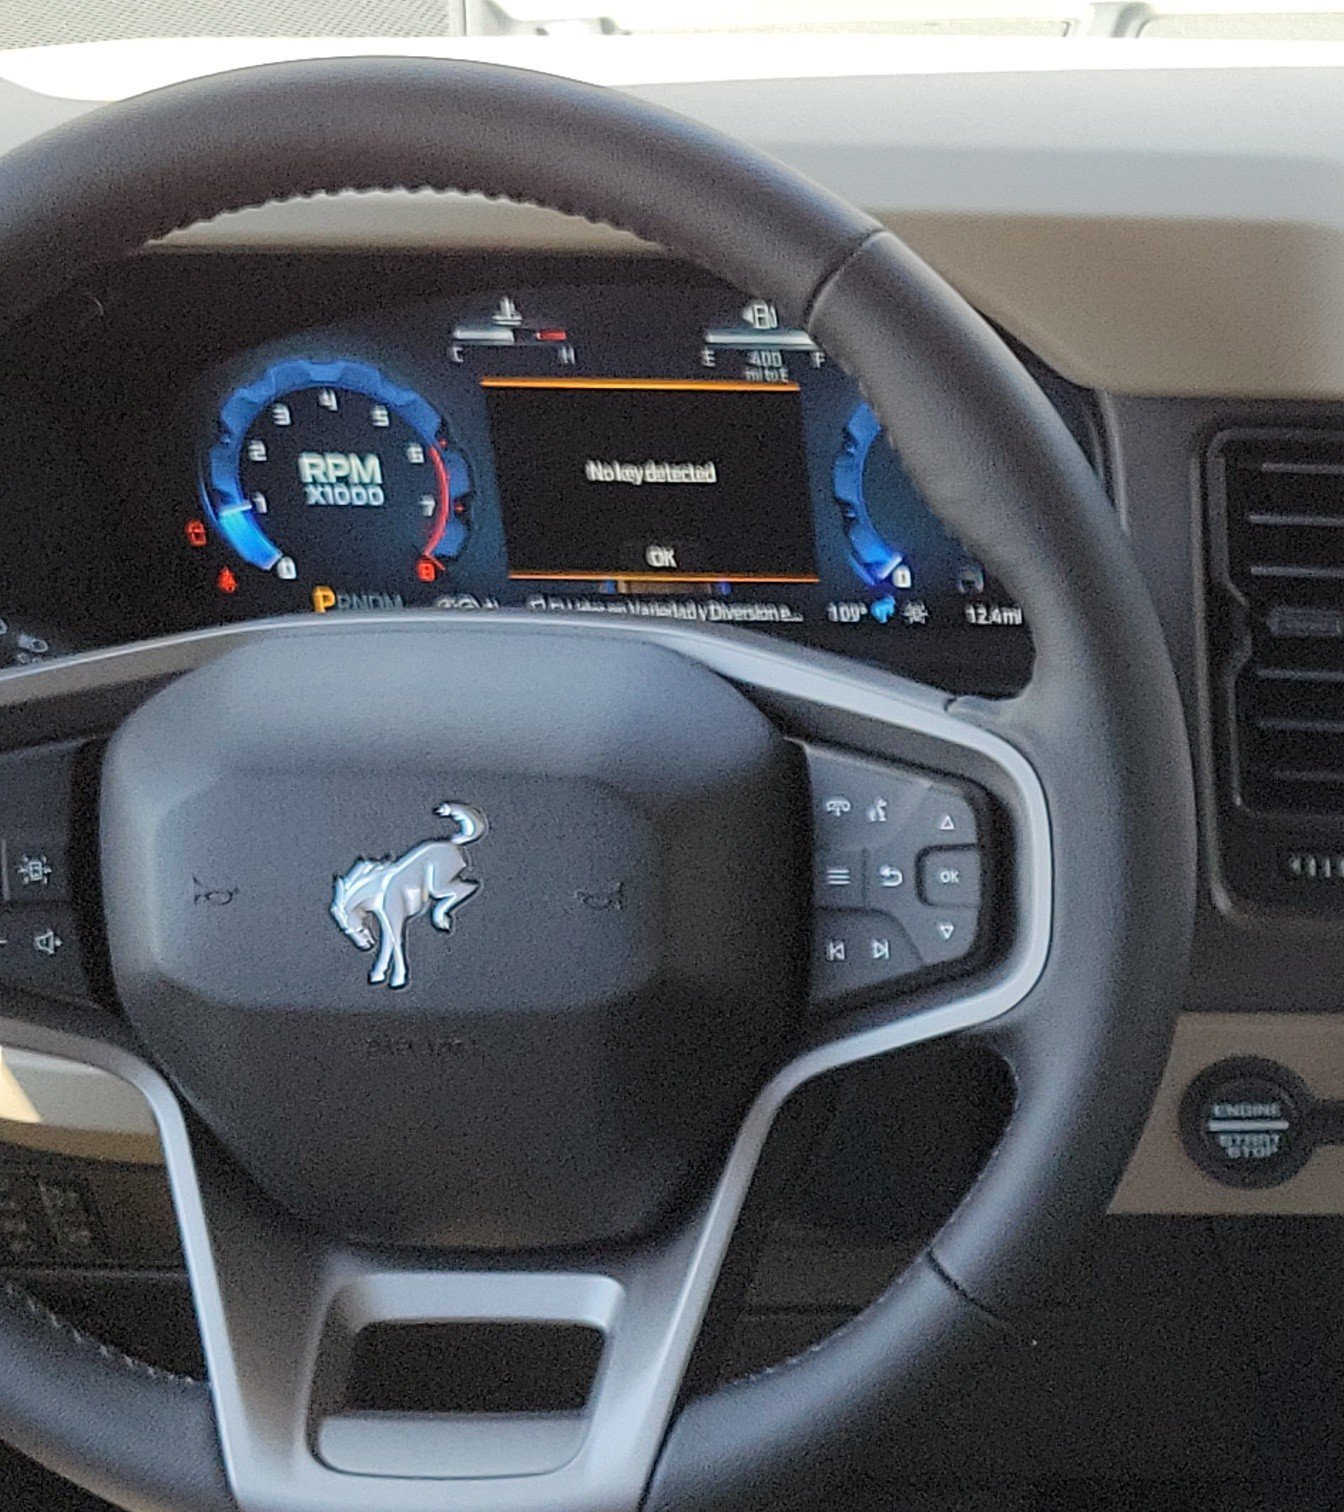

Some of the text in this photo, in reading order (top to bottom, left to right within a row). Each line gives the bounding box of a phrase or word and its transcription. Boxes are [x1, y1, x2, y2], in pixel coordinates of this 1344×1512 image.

[319, 389, 338, 411] 4
[272, 403, 291, 427] 3
[370, 404, 389, 427] 5
[249, 439, 267, 461] 2
[405, 443, 424, 463] 6
[299, 453, 382, 484] RPM
[421, 494, 436, 517] 7
[645, 546, 678, 569] OK
[940, 869, 960, 884] OK
